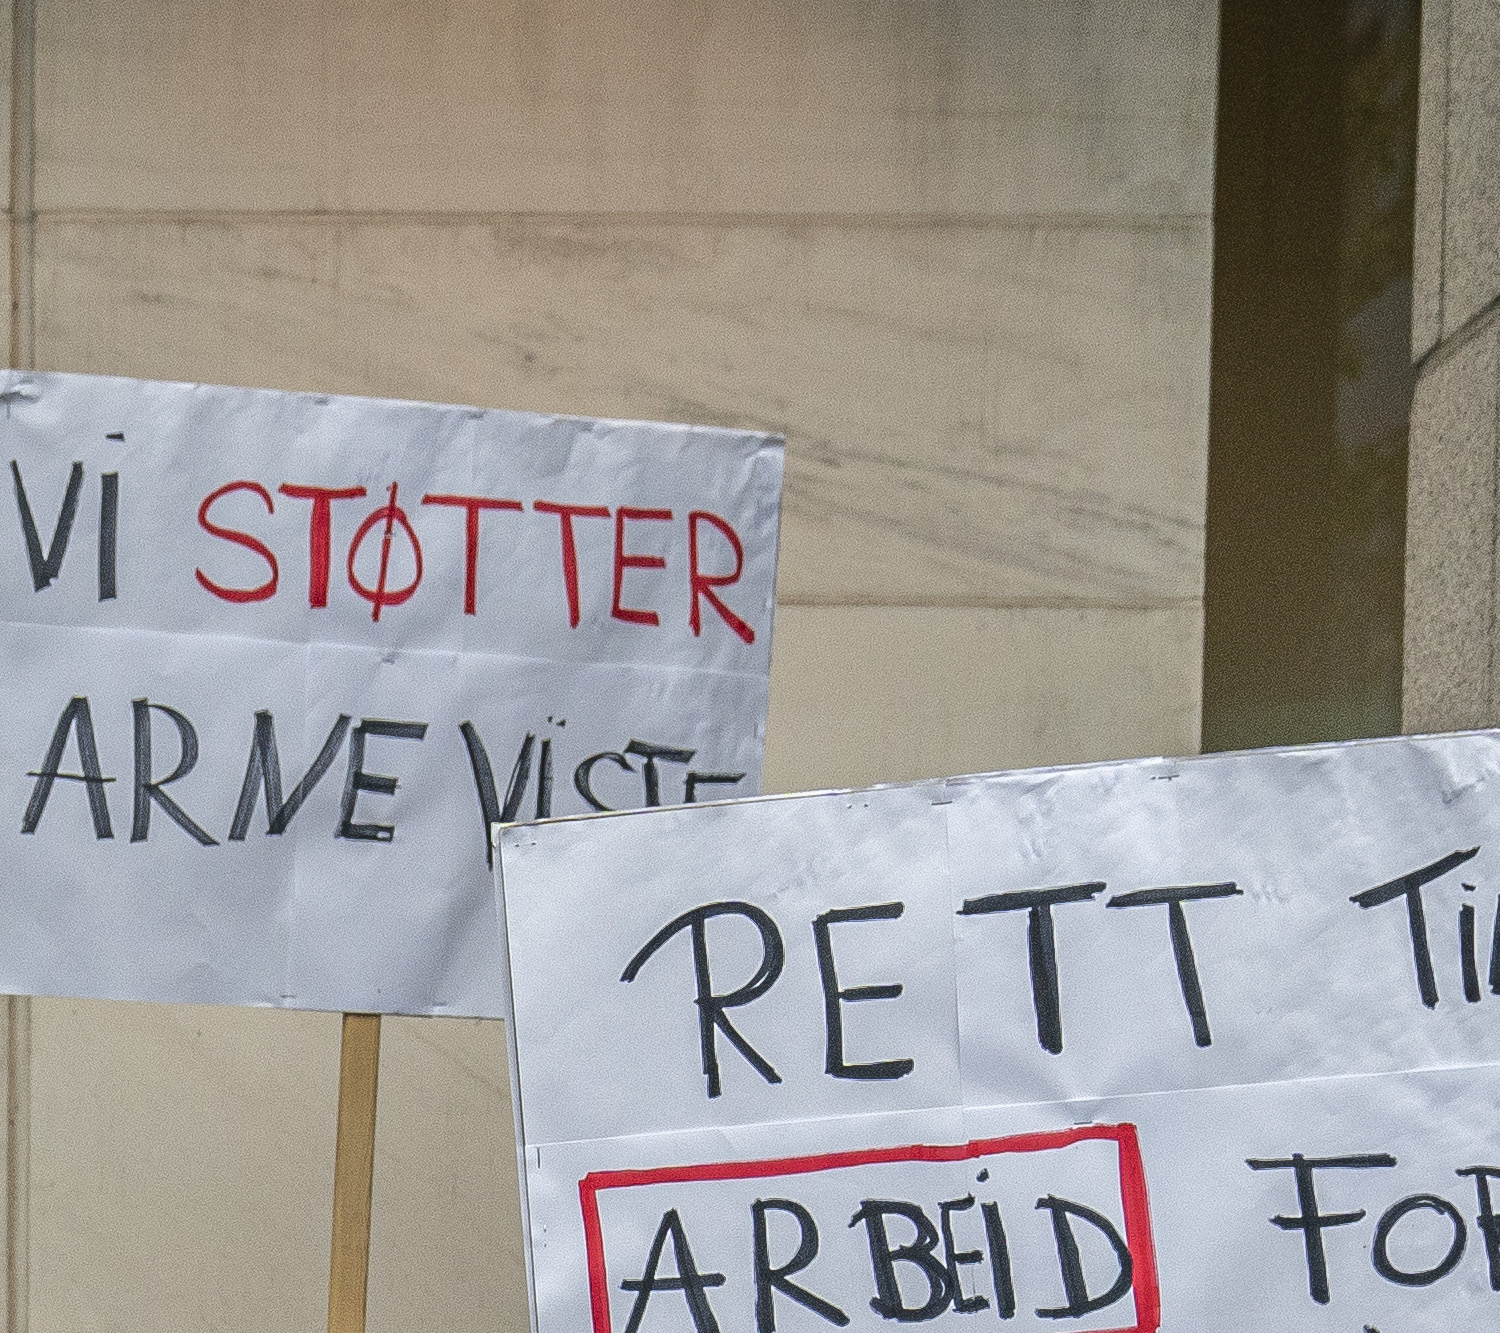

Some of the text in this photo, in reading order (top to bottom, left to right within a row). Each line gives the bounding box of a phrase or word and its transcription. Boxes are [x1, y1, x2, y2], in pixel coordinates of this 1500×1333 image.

[11, 432, 755, 643] VI STØTTER
[22, 697, 428, 846] ARNE
[621, 882, 1241, 1098] RETT
